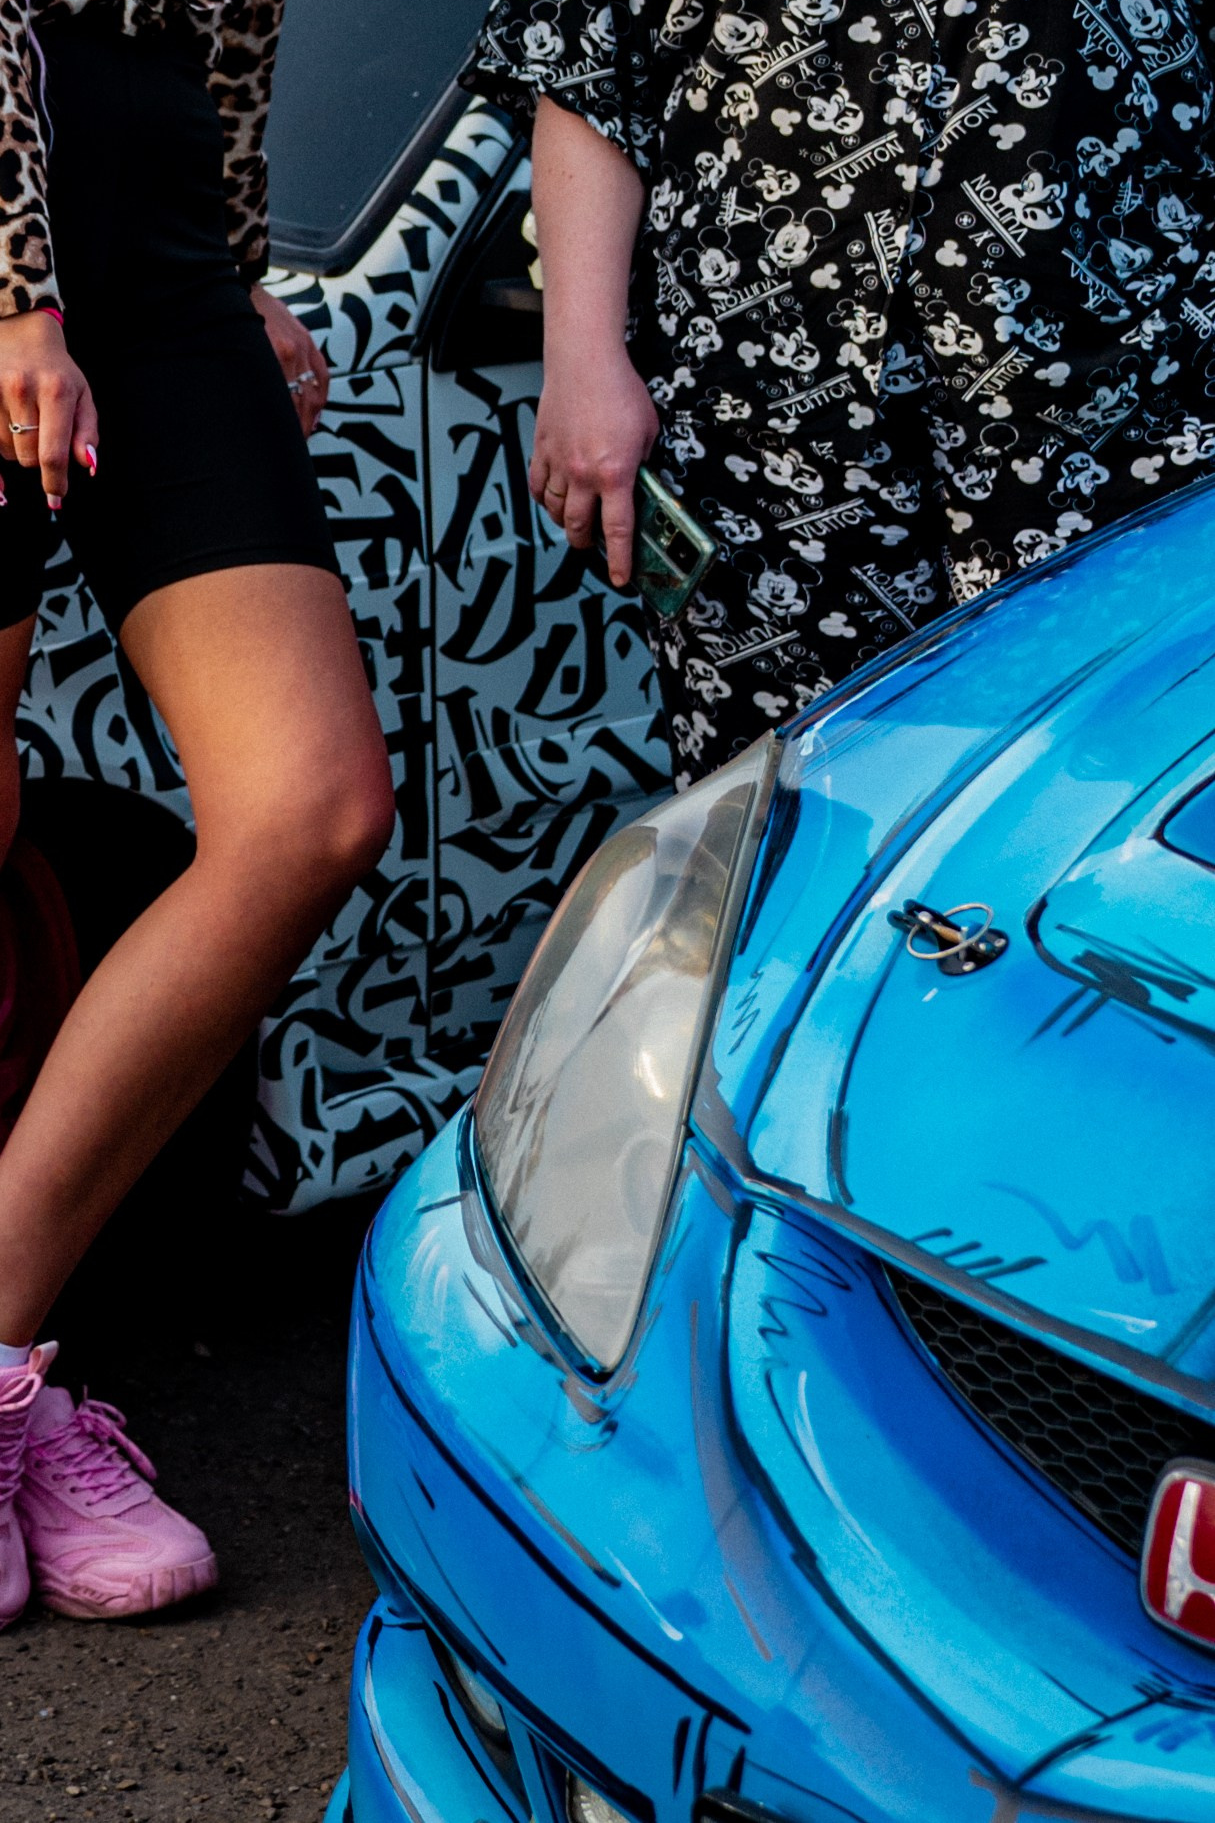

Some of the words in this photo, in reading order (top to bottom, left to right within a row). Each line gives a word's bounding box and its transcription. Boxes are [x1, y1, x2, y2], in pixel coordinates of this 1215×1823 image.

[744, 35, 809, 81] VUITTON
[1071, 2, 1130, 70] VUITTON
[541, 57, 601, 85] VUITTO
[935, 101, 999, 153] UITTON
[830, 139, 906, 184] VUITTON
[970, 173, 1029, 244] VUITTON
[710, 277, 779, 316] VUITTON
[977, 350, 1035, 397] VUITTON
[782, 380, 857, 418] VUITTON
[794, 504, 876, 540] VUITTON
[863, 562, 918, 620] VUITTON
[704, 622, 782, 661] VUITTON
